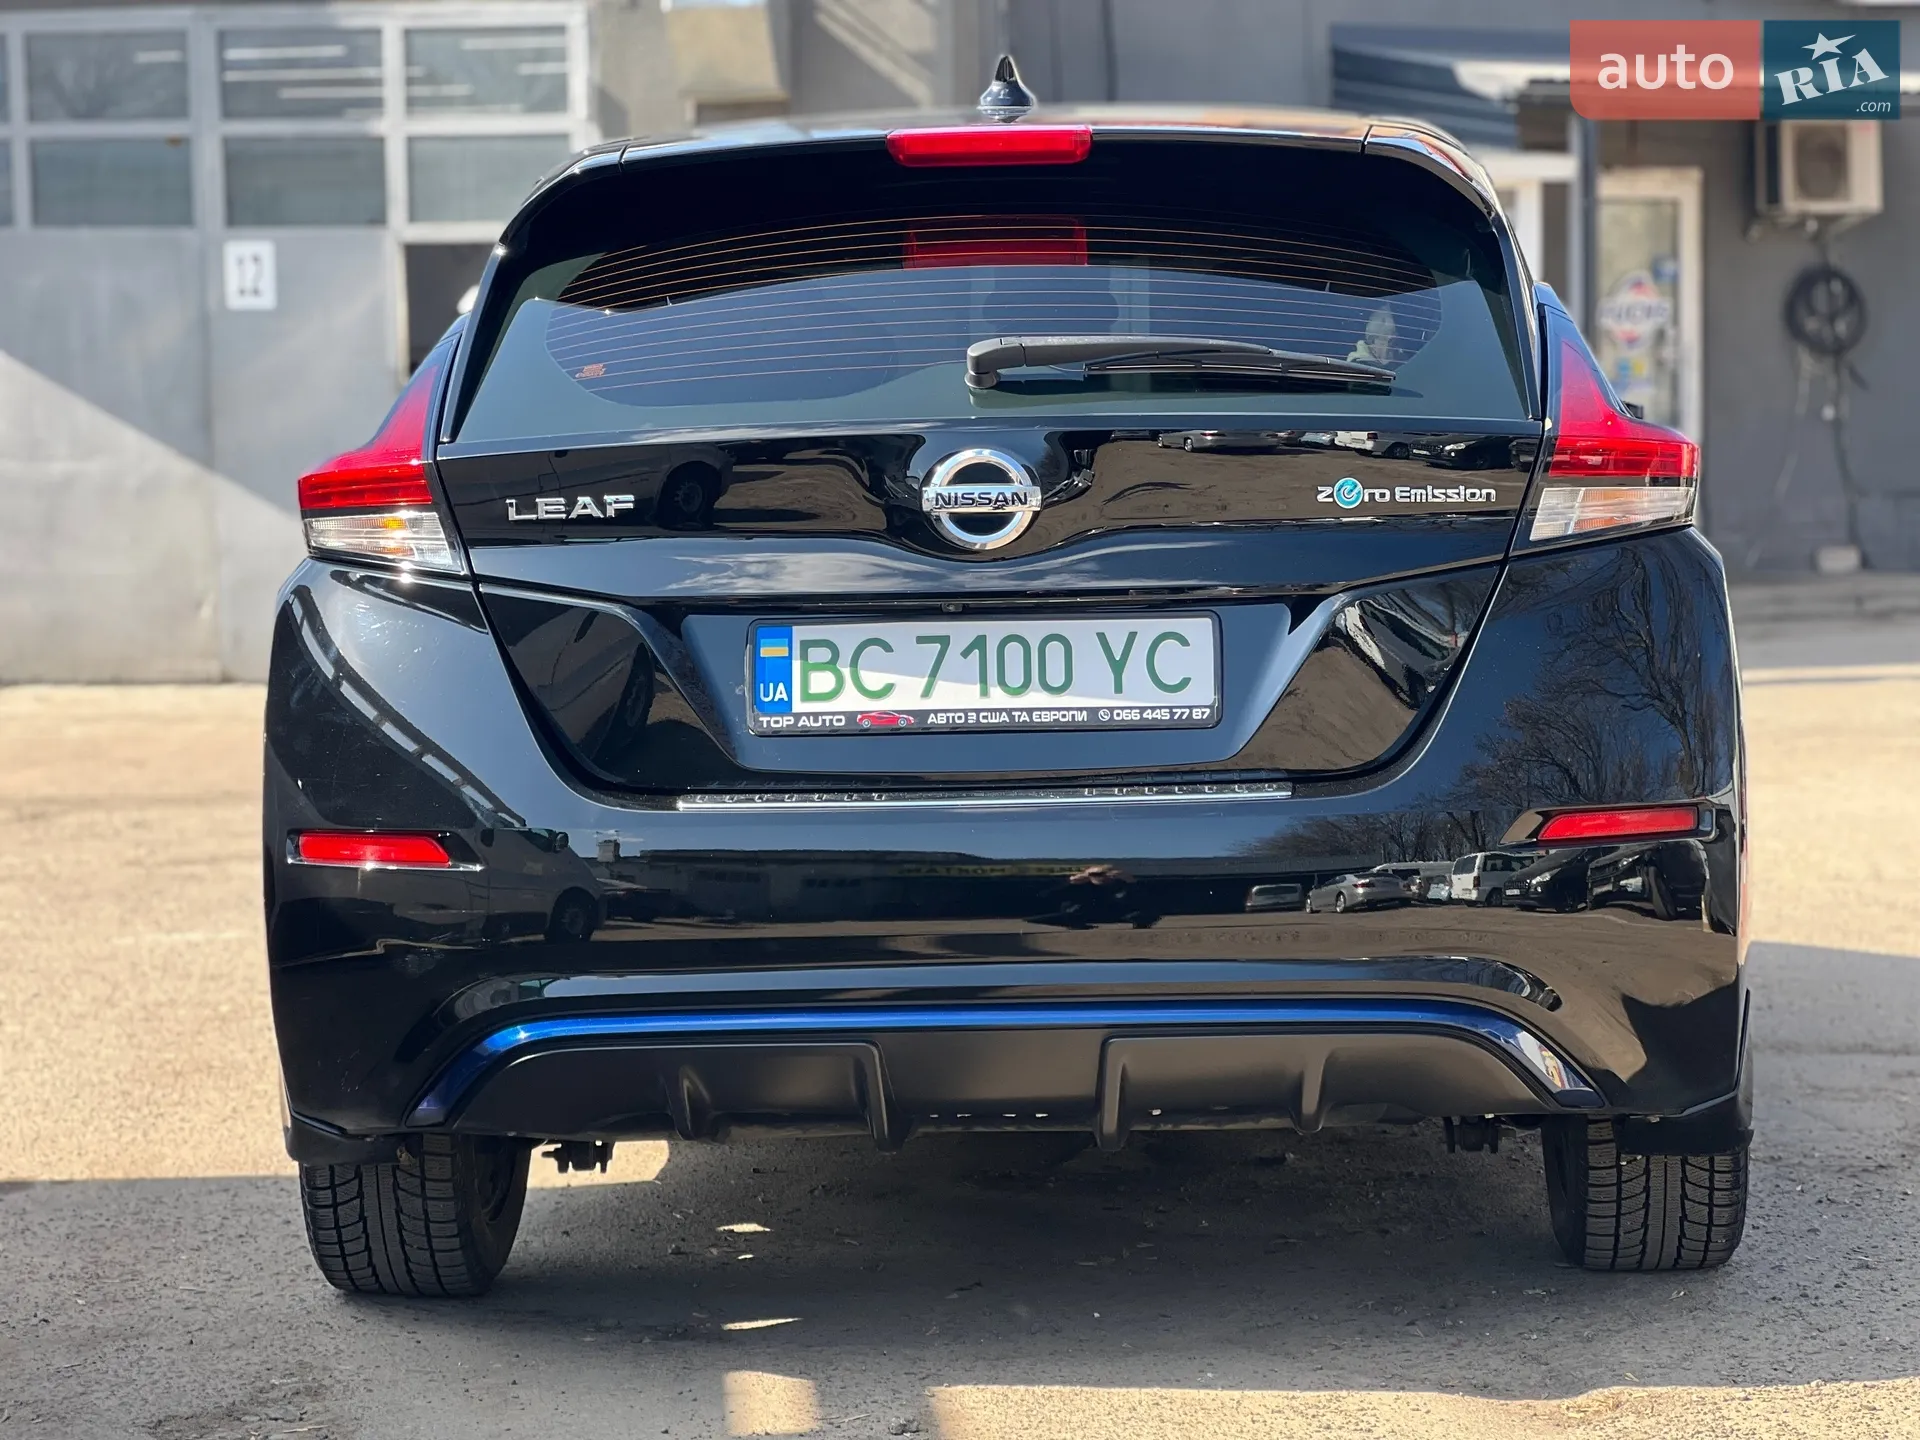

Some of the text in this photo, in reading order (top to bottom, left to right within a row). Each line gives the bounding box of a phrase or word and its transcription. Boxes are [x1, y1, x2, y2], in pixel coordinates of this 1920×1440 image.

[935, 491, 1028, 507] NISSAN
[1395, 484, 1496, 503] Emission
[506, 494, 635, 521] LEAF
[799, 630, 1192, 702] BC 7100 YC
[760, 682, 788, 702] UA
[759, 714, 845, 728] TOP AUTO
[927, 712, 965, 724] АВТО
[979, 711, 1009, 723] США
[1012, 711, 1030, 722] ТА
[1032, 710, 1088, 722] ЄВРОПИ
[1113, 709, 1140, 721] 066
[1143, 708, 1170, 720] 445
[1172, 708, 1190, 720] 77
[1192, 708, 1210, 720] 87
